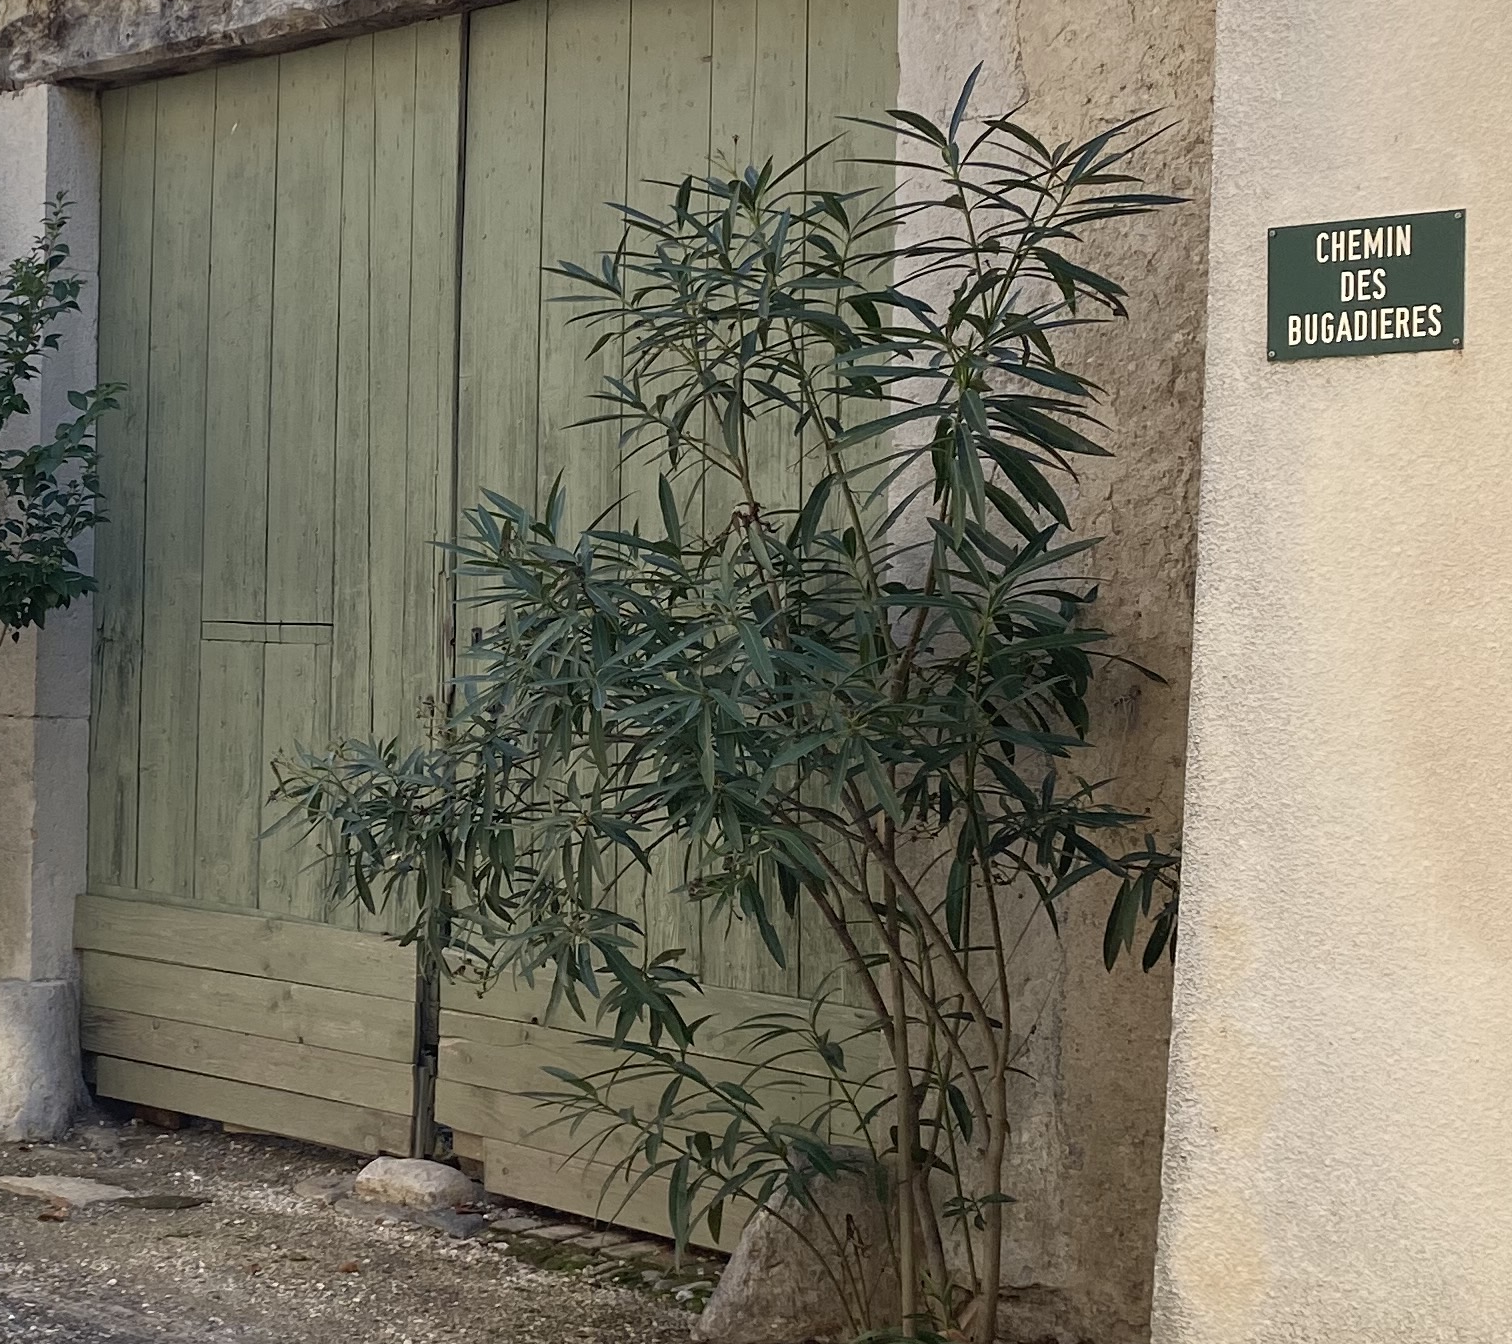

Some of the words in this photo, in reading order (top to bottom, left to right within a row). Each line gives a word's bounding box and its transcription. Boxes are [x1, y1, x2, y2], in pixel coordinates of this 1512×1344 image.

[1315, 224, 1412, 263] CHEMIN
[1341, 268, 1387, 302] DES
[1288, 304, 1442, 346] BUGADIERES
